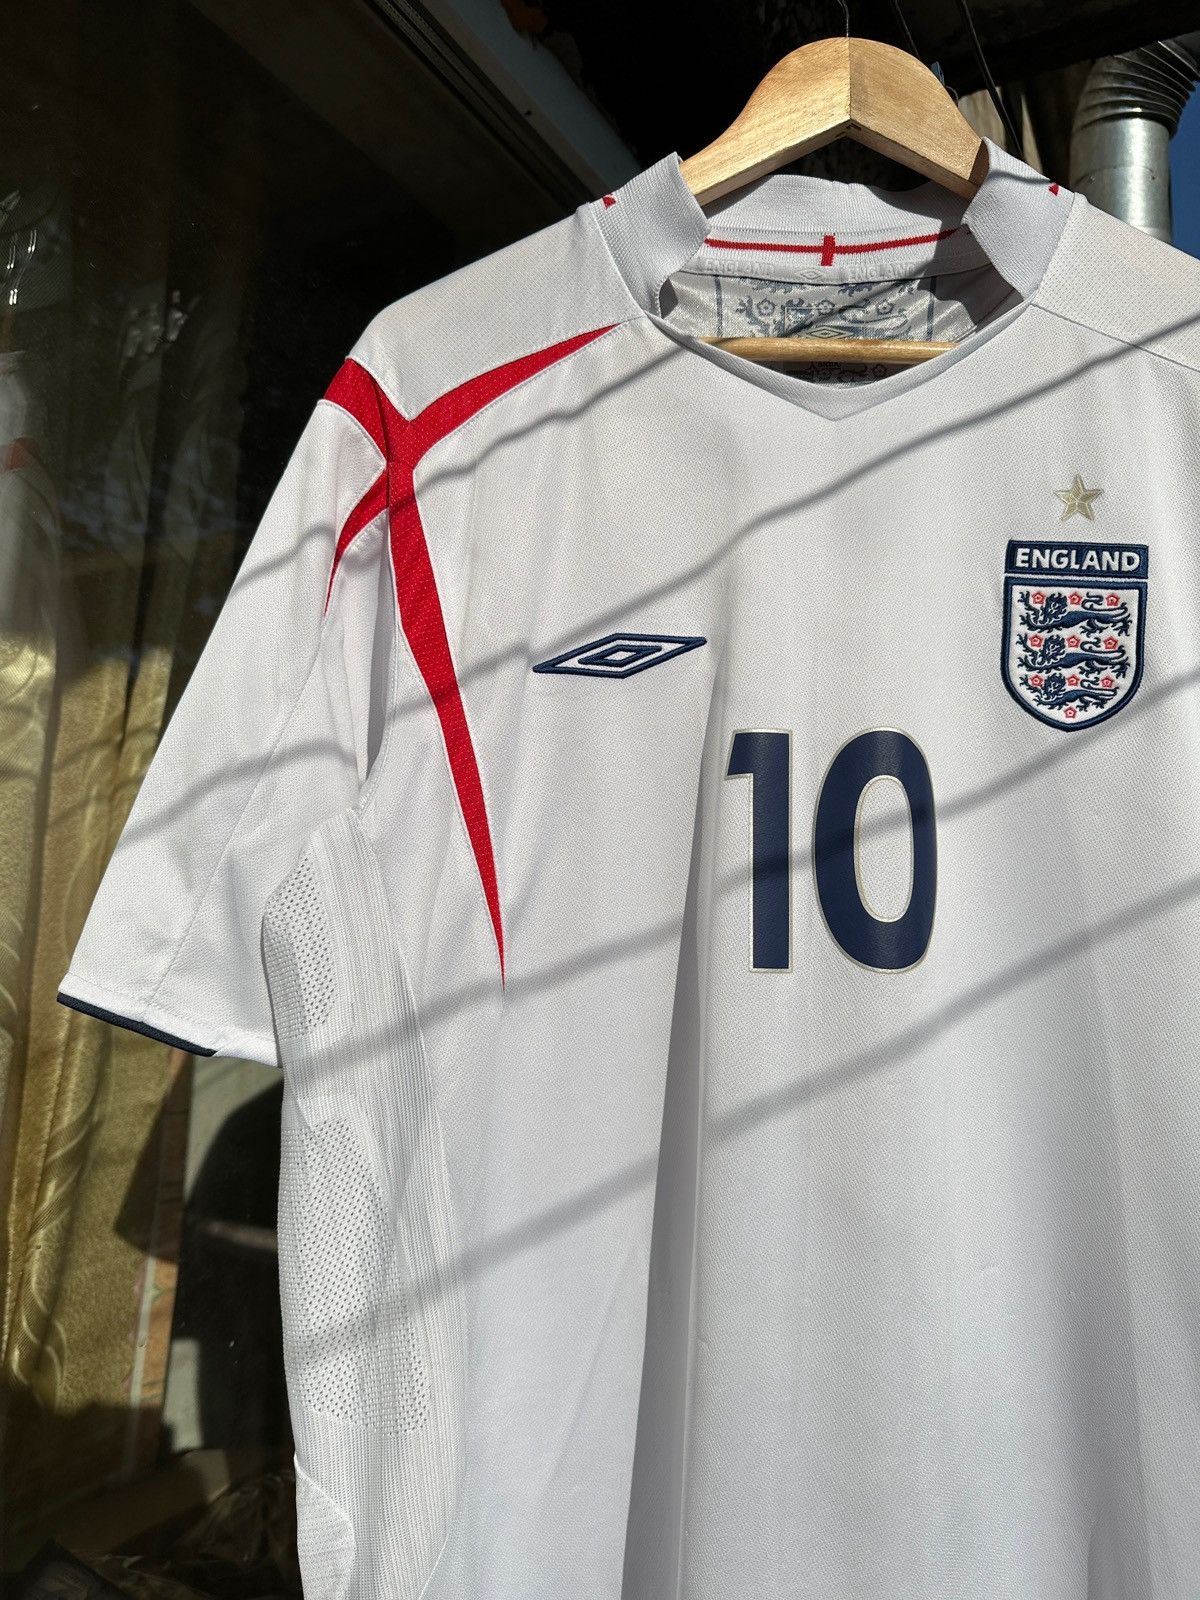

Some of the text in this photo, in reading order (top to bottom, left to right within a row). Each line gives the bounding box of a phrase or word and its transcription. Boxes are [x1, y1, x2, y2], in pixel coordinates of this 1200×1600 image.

[704, 258, 775, 276] ENGLAND
[1015, 547, 1140, 572] ENGLAND
[725, 727, 937, 973] 10
